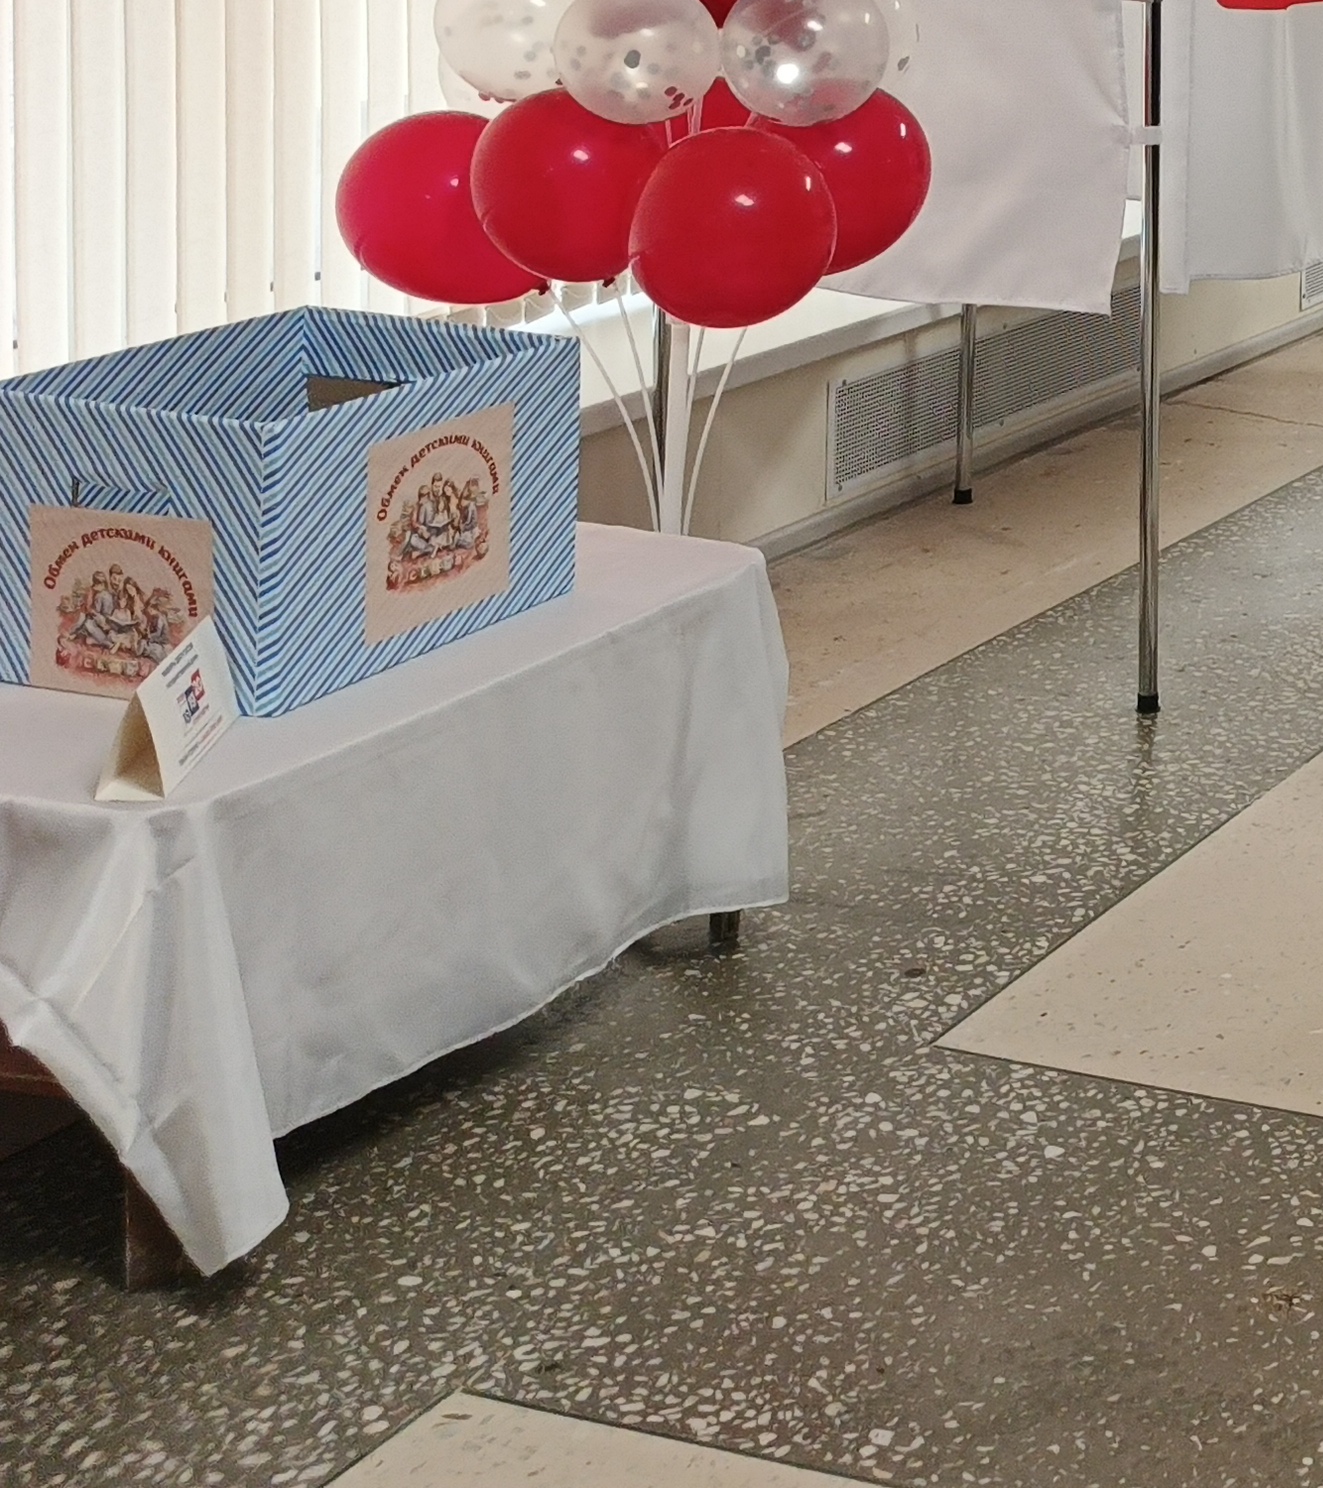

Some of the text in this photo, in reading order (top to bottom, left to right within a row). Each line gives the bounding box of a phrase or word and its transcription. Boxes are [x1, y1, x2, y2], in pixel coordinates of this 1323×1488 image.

[376, 434, 500, 522] Обмен детскими книгами
[44, 528, 198, 618] Обмен детскими книгами
